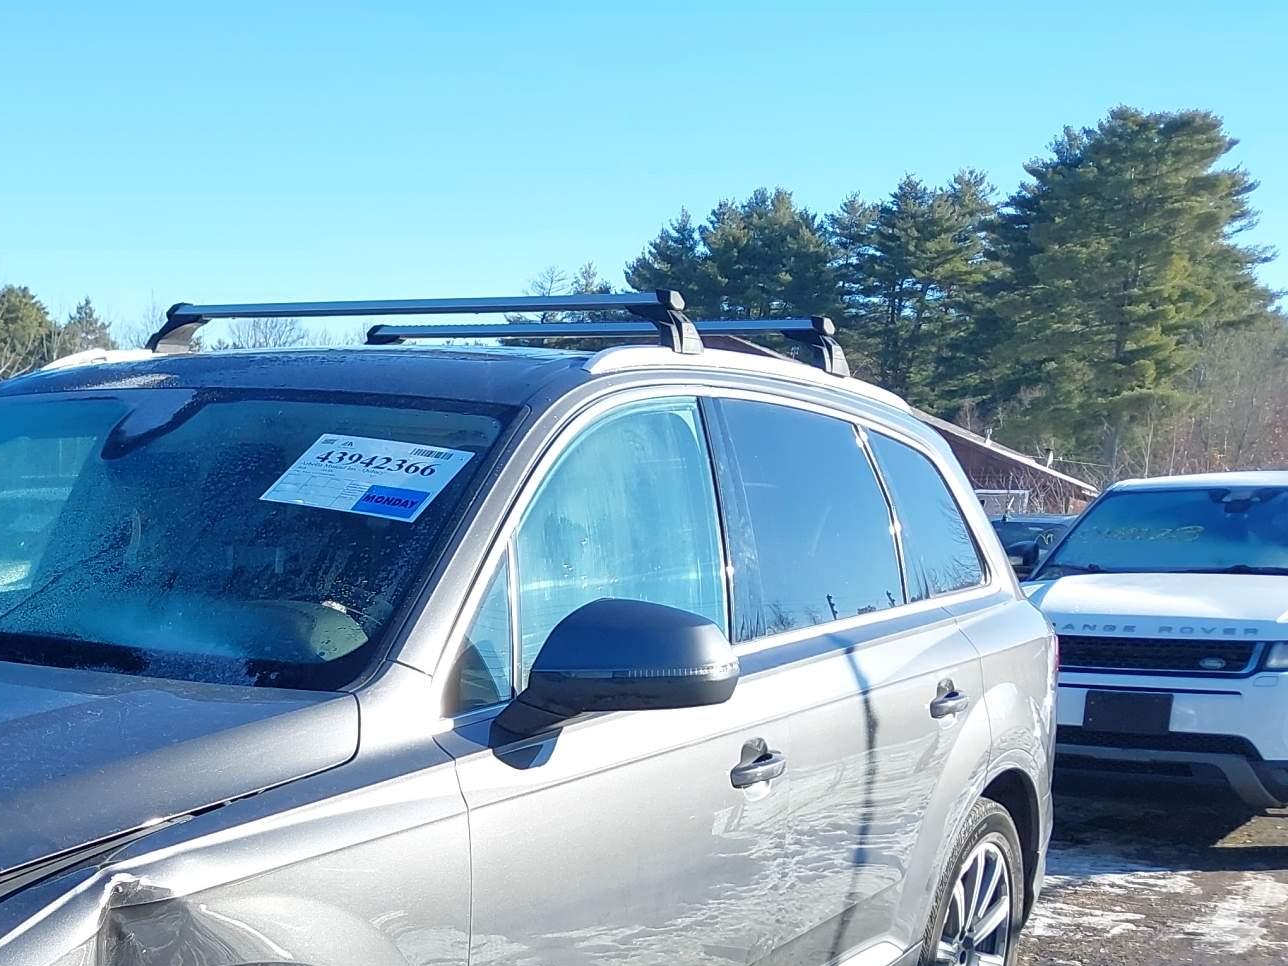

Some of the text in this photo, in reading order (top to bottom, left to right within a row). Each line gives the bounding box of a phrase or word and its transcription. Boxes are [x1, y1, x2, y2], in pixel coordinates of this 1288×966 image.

[316, 450, 441, 477] 43942366
[362, 493, 416, 509] MONDAY
[1053, 622, 1260, 636] ANGE ROVER
